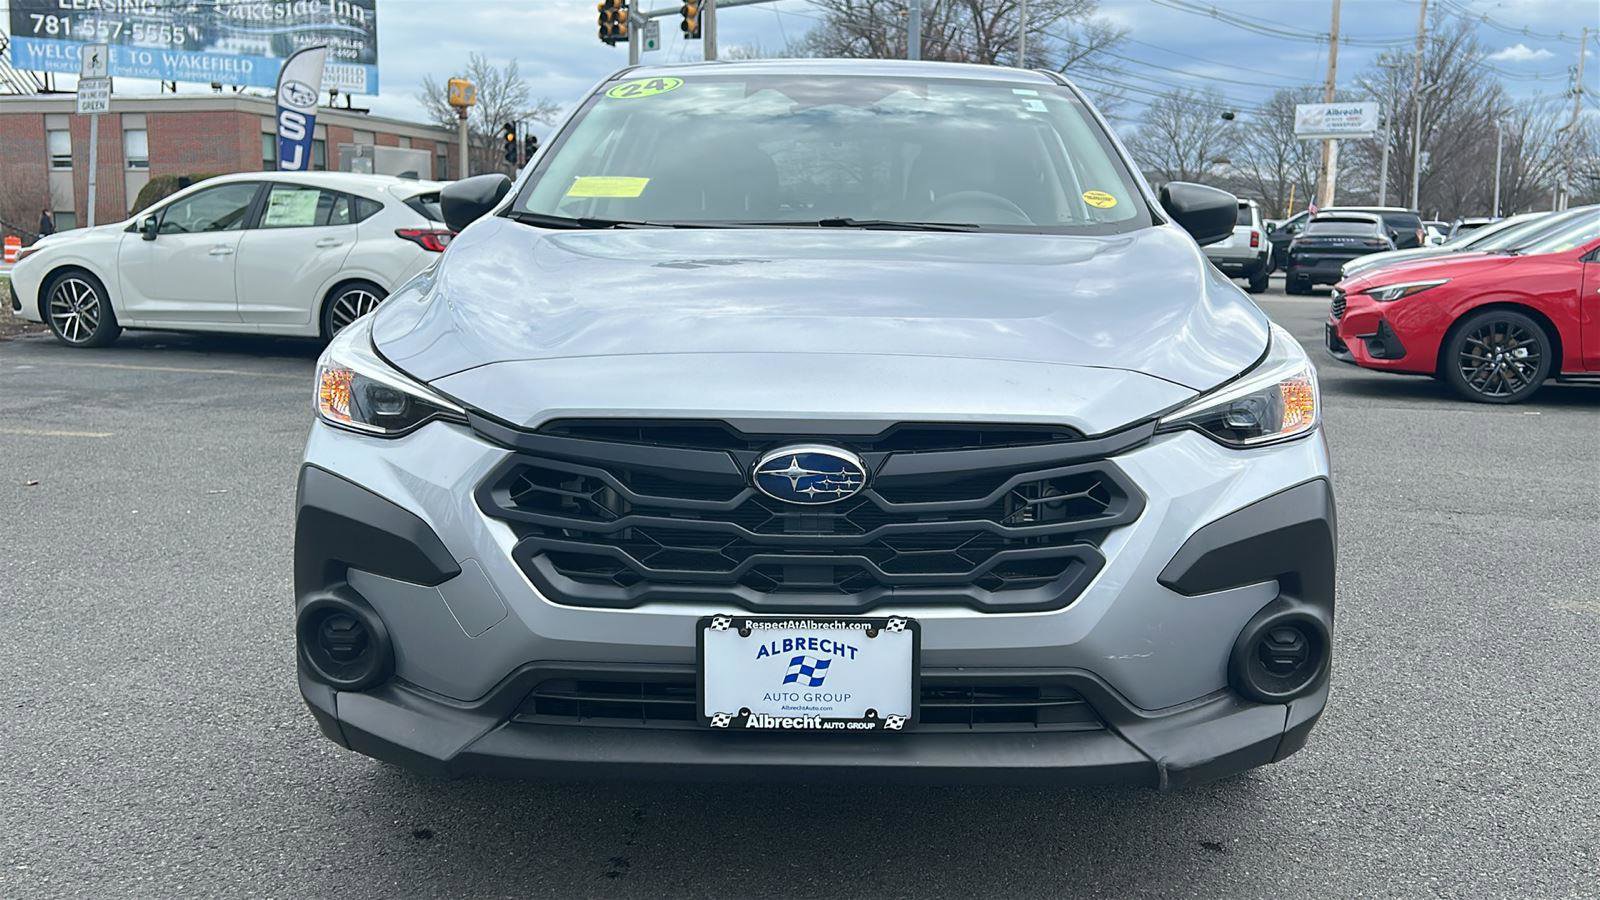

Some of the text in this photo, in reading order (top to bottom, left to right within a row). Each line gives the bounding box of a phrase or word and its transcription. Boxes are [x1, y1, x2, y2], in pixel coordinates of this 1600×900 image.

[59, 0, 156, 15] LEASING
[329, 0, 366, 24] Inn
[30, 13, 185, 45] 781-557-5555
[27, 42, 253, 74] WELCE TO WAKEFIELD
[620, 79, 667, 97] 24
[82, 101, 105, 110] GREEN
[1326, 108, 1363, 116] Albrecht
[745, 620, 872, 631] RespectAtAlbrecht.com
[756, 637, 859, 660] ALBRECHT
[763, 692, 851, 703] AUTO GROUP
[745, 713, 876, 730] Albrecht AUTO GROUP
